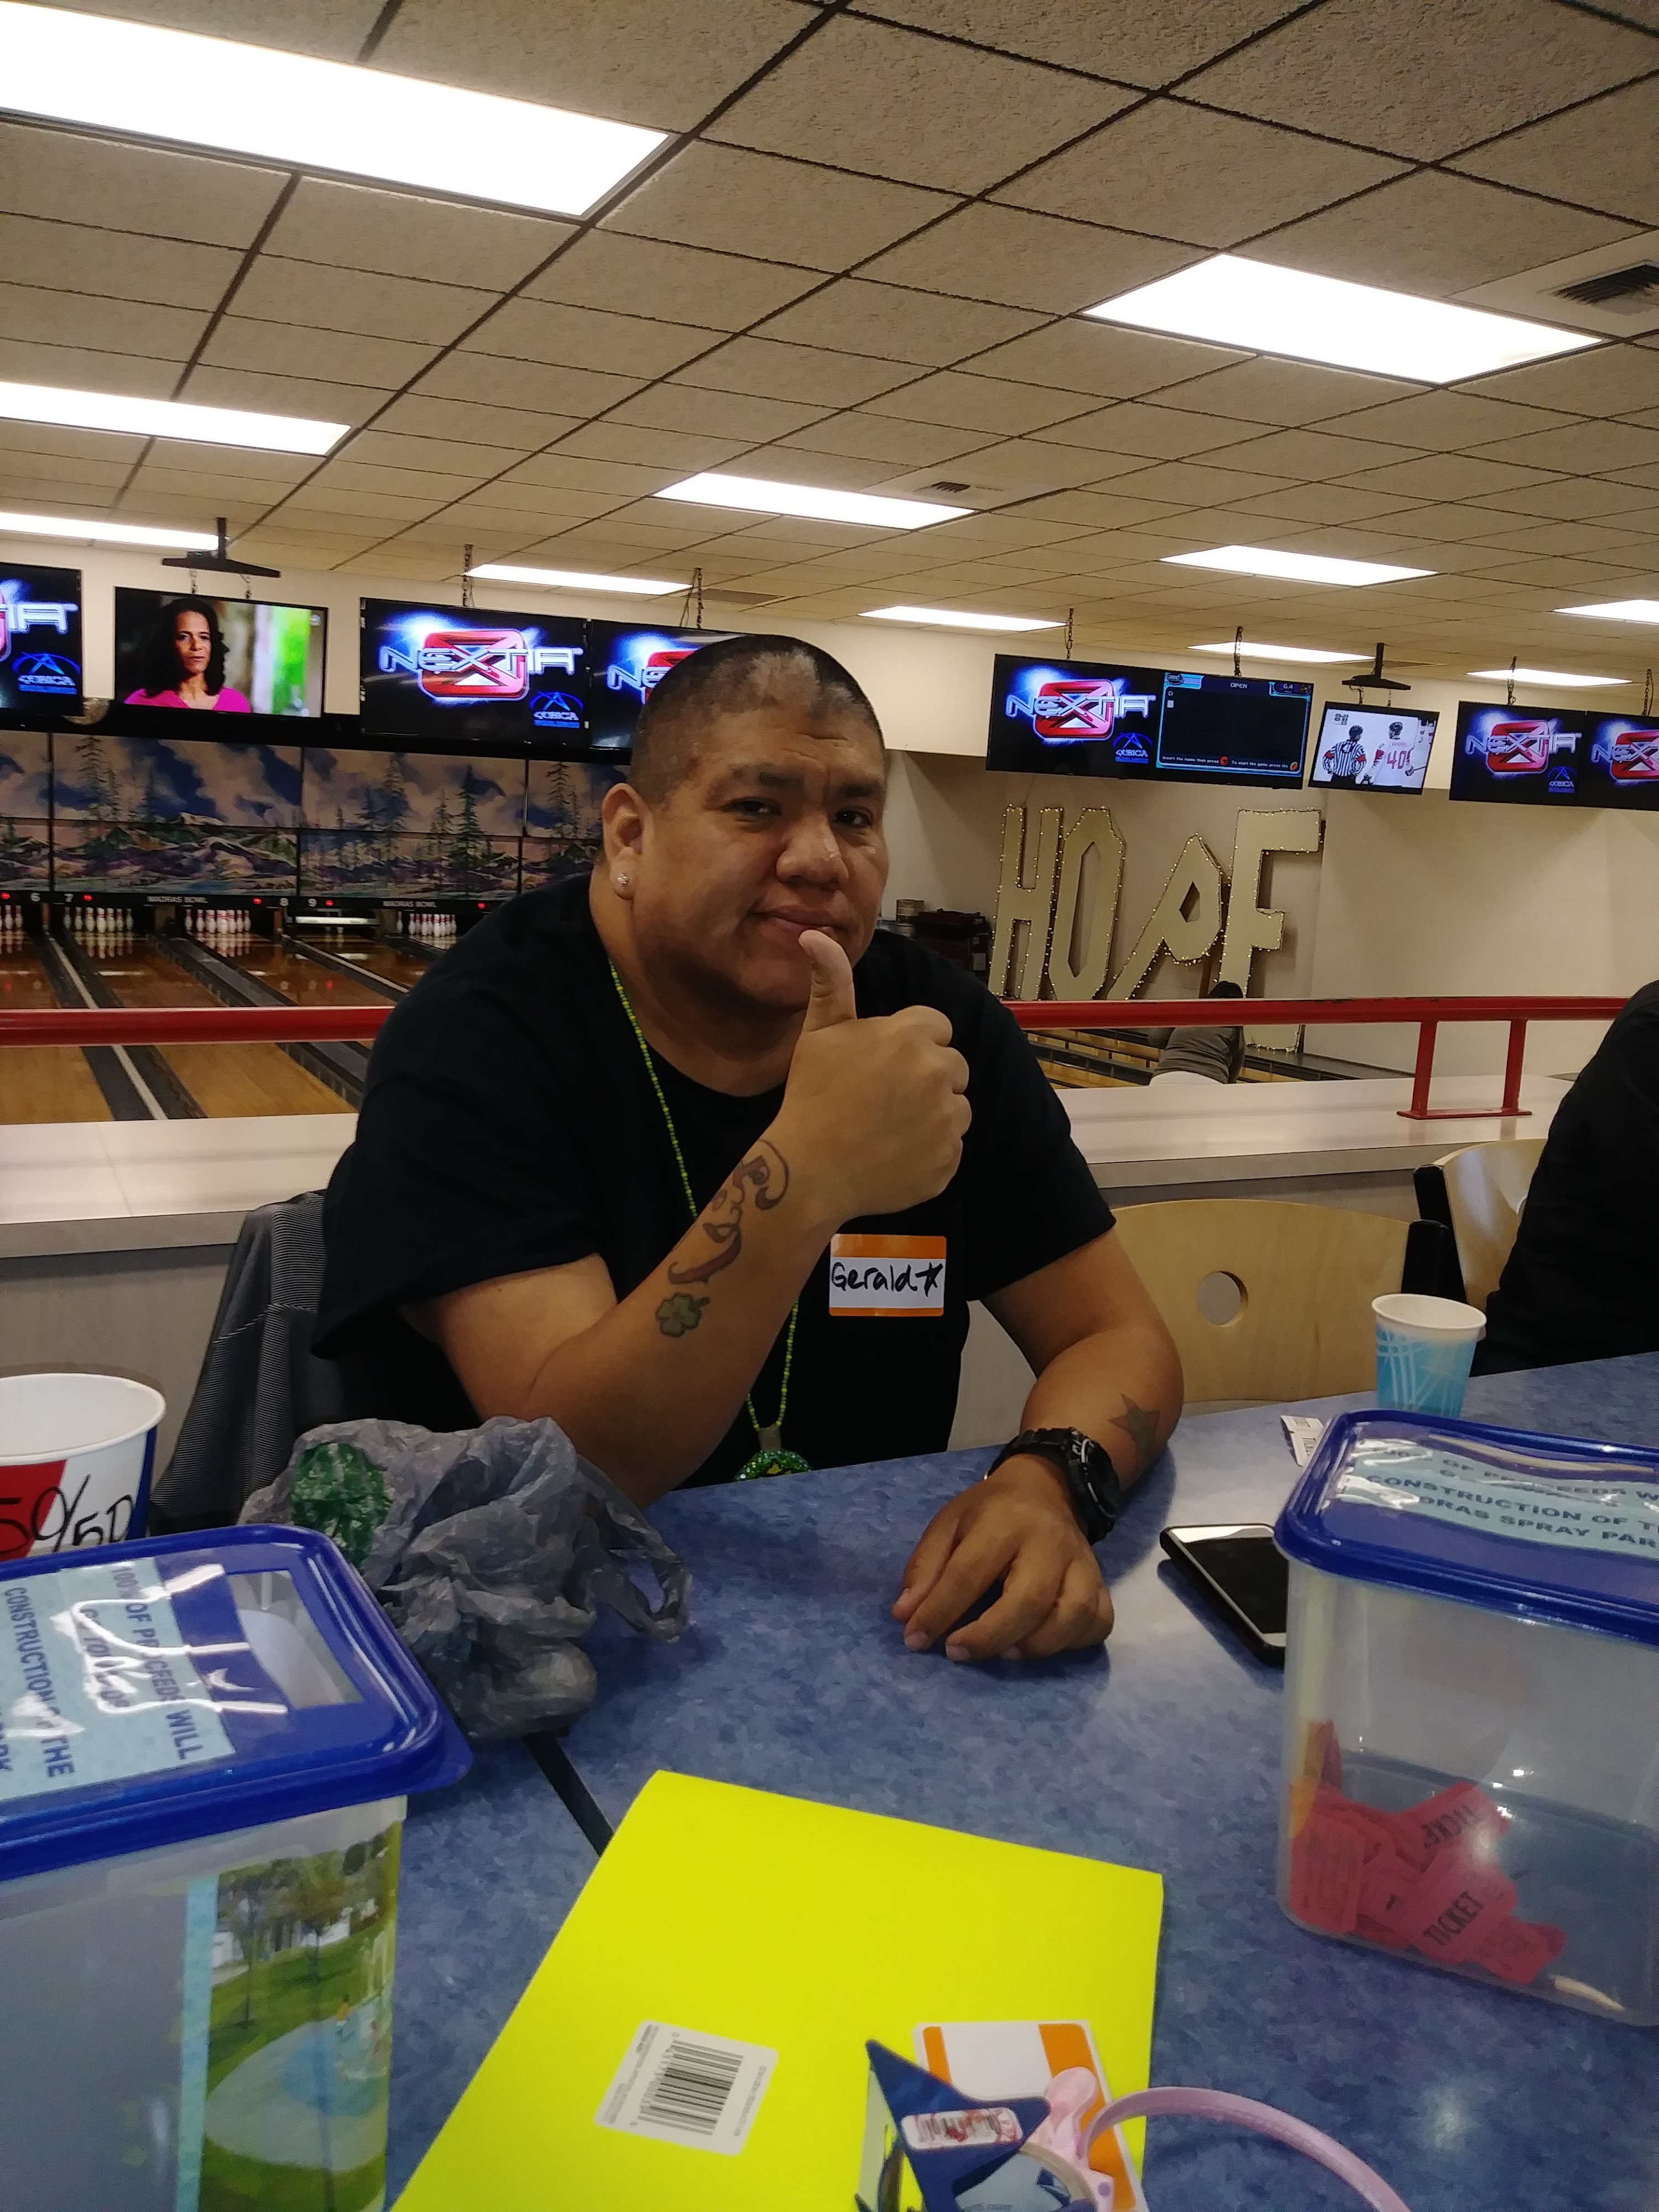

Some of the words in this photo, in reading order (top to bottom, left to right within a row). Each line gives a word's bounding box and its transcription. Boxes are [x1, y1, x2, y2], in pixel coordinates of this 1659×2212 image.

[1387, 750, 1407, 769] 40
[30, 893, 41, 902] 6
[64, 893, 74, 902] 7
[279, 898, 289, 907] 8
[307, 898, 318, 907] 9
[831, 1261, 918, 1292] Gerald
[1366, 1475, 1582, 1521] CONSTRUCTION
[1592, 1515, 1628, 1525] OF
[1500, 1515, 1590, 1536] SPRAY
[4, 1587, 55, 1701] CONSTRUCTION
[165, 1709, 204, 1760] WILL
[1422, 1890, 1485, 1947] TICKET
